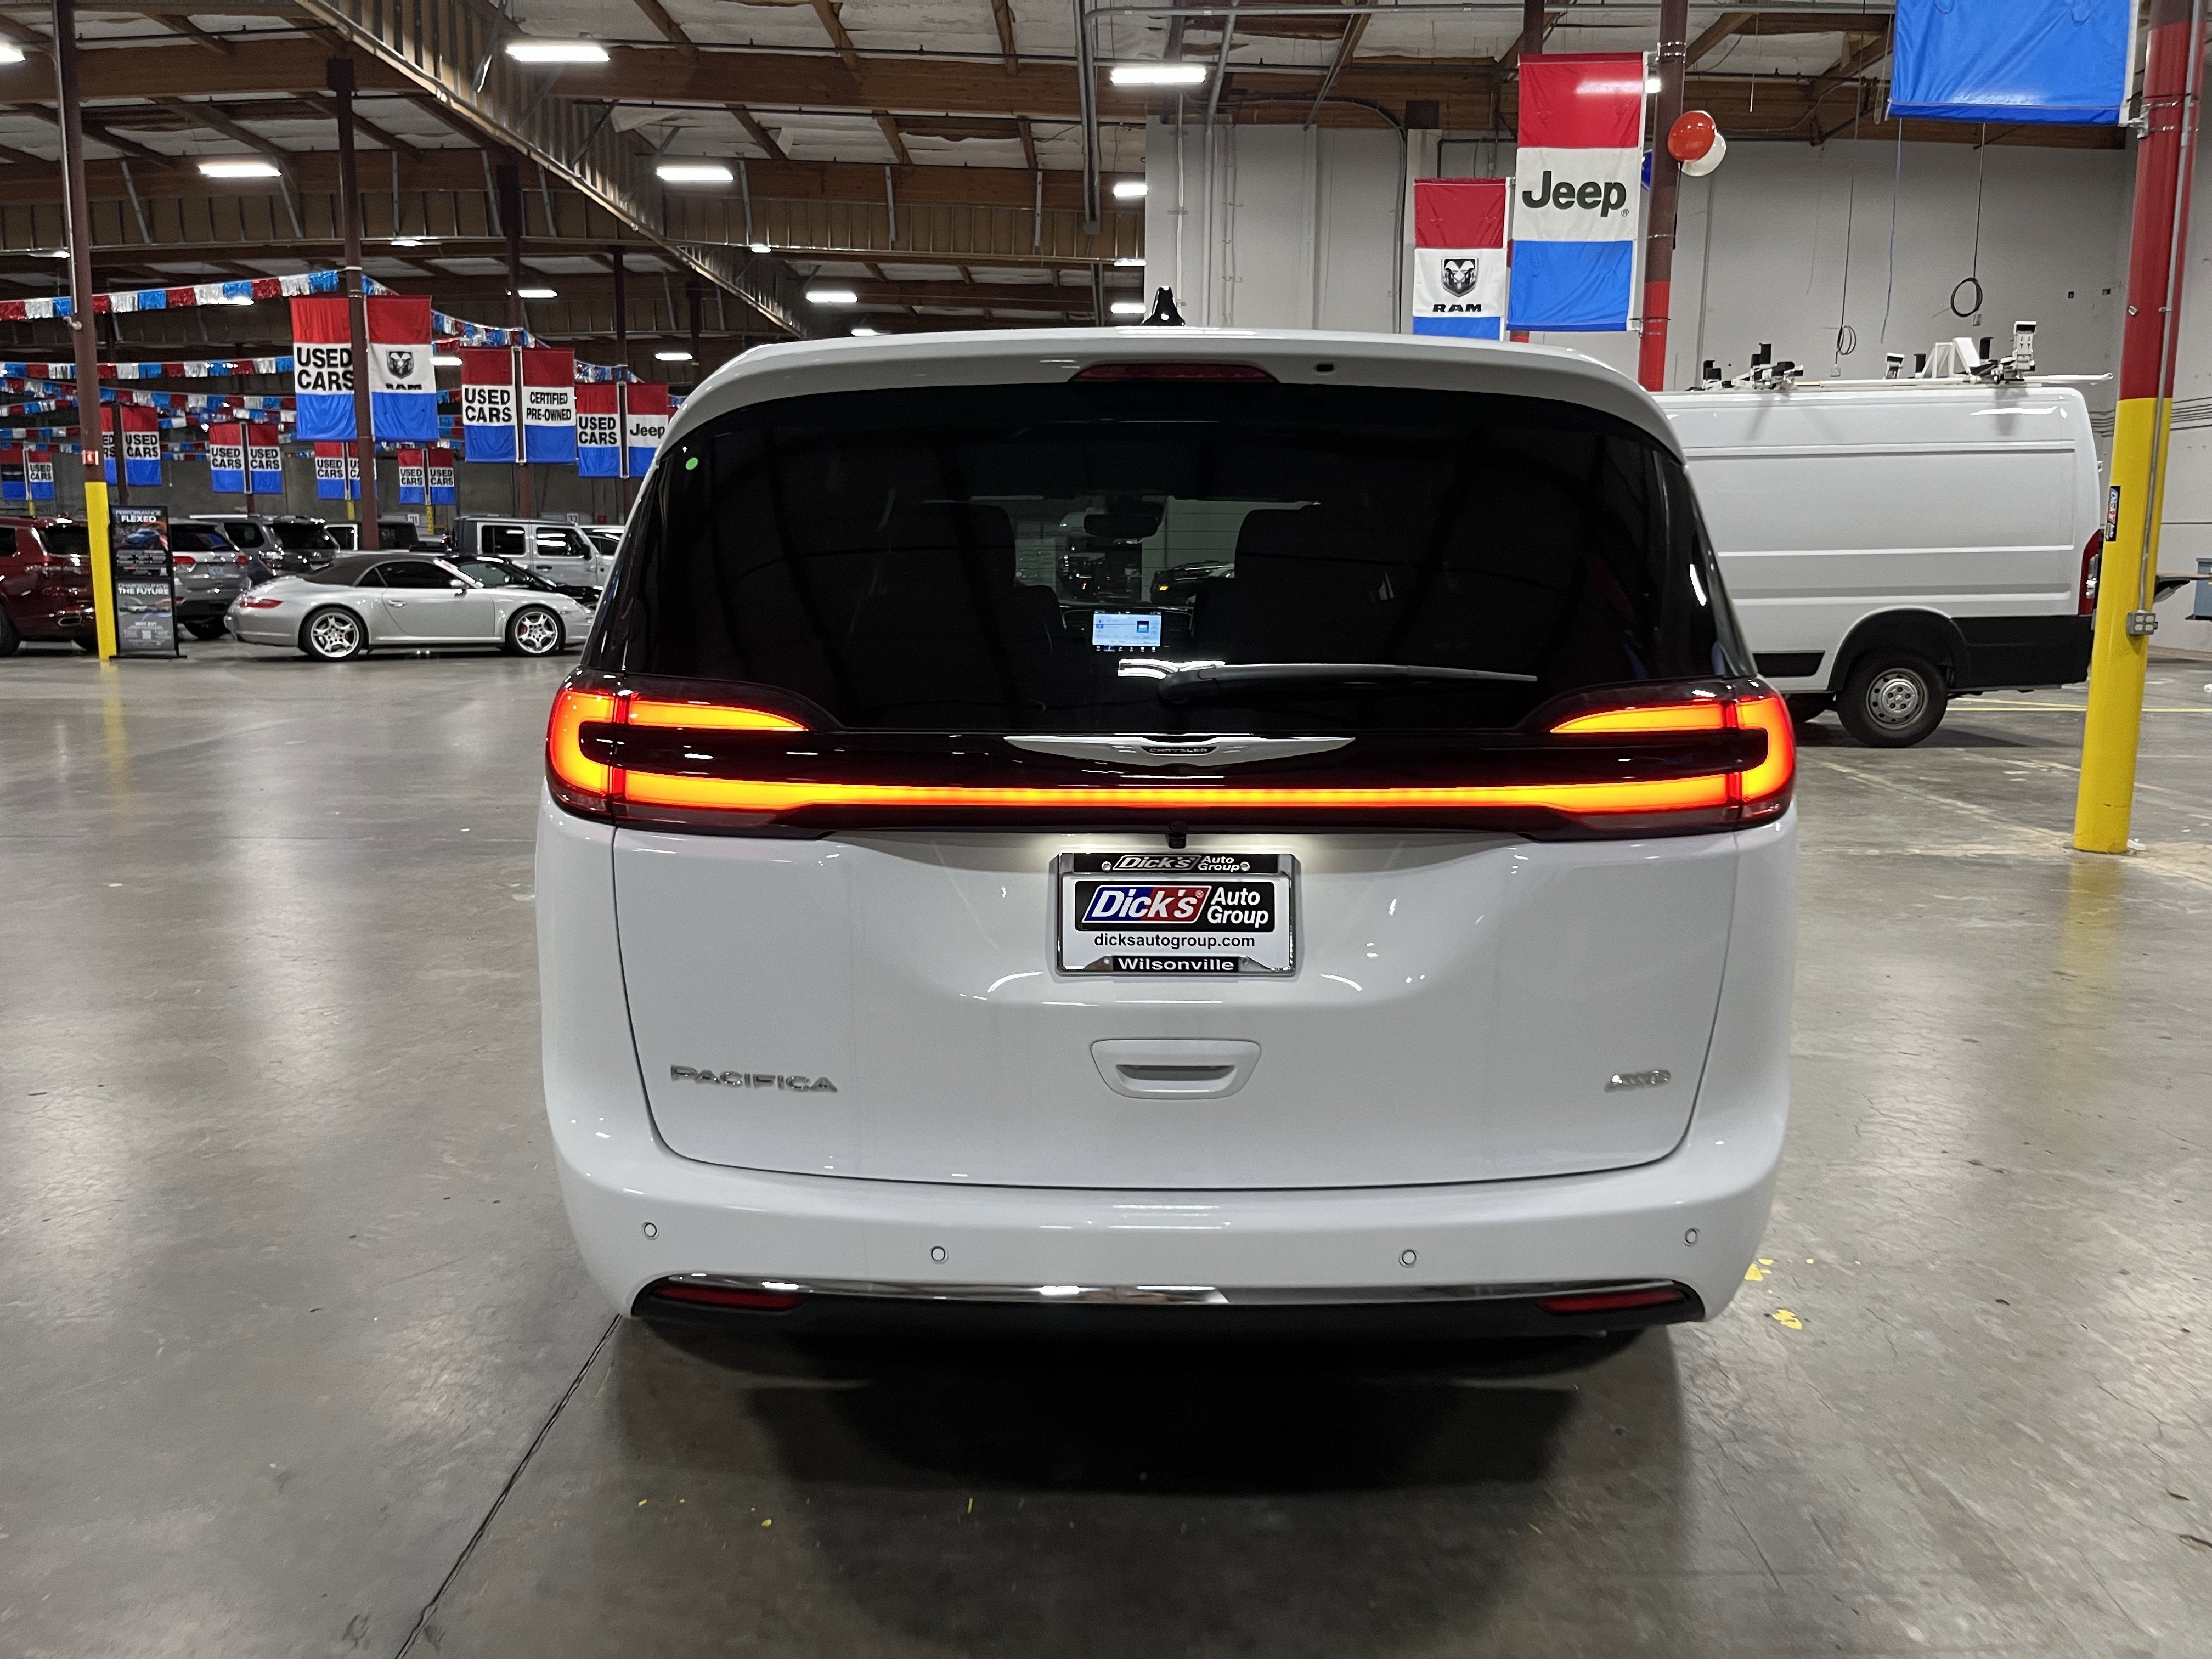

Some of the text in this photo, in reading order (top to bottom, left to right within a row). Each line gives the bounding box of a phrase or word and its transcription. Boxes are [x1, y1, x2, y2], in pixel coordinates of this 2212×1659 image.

[1522, 171, 1627, 217] Jeep
[1432, 304, 1482, 312] RAM
[297, 347, 352, 368] USED
[297, 369, 354, 391] CARS
[465, 388, 510, 405] USED
[530, 392, 568, 405] CERTIFIED
[465, 405, 512, 422] CARS
[526, 407, 572, 421] PRE-OWNED
[579, 416, 617, 430] USED
[630, 423, 665, 439] Jeep
[126, 434, 157, 445] USED
[579, 431, 617, 445] CARS
[127, 447, 159, 457] CARS
[212, 448, 240, 457] USED
[250, 449, 278, 458] USED
[212, 459, 241, 469] CARS
[251, 460, 279, 469] CARS
[317, 460, 342, 468] USED
[318, 469, 343, 478] CARS
[400, 469, 422, 477] USED
[430, 469, 453, 477] USED
[401, 477, 423, 486] CARS
[431, 477, 453, 486] CARS
[1119, 857, 1192, 868] Dick's
[1198, 863, 1240, 872] Group
[1210, 887, 1261, 906] Auto
[1091, 889, 1197, 918] Dick's
[1207, 905, 1269, 928] Group
[1094, 933, 1255, 950] dicksautogroup.com
[1118, 957, 1234, 970] Wilsonville
[670, 1065, 838, 1092] PACIFICA
